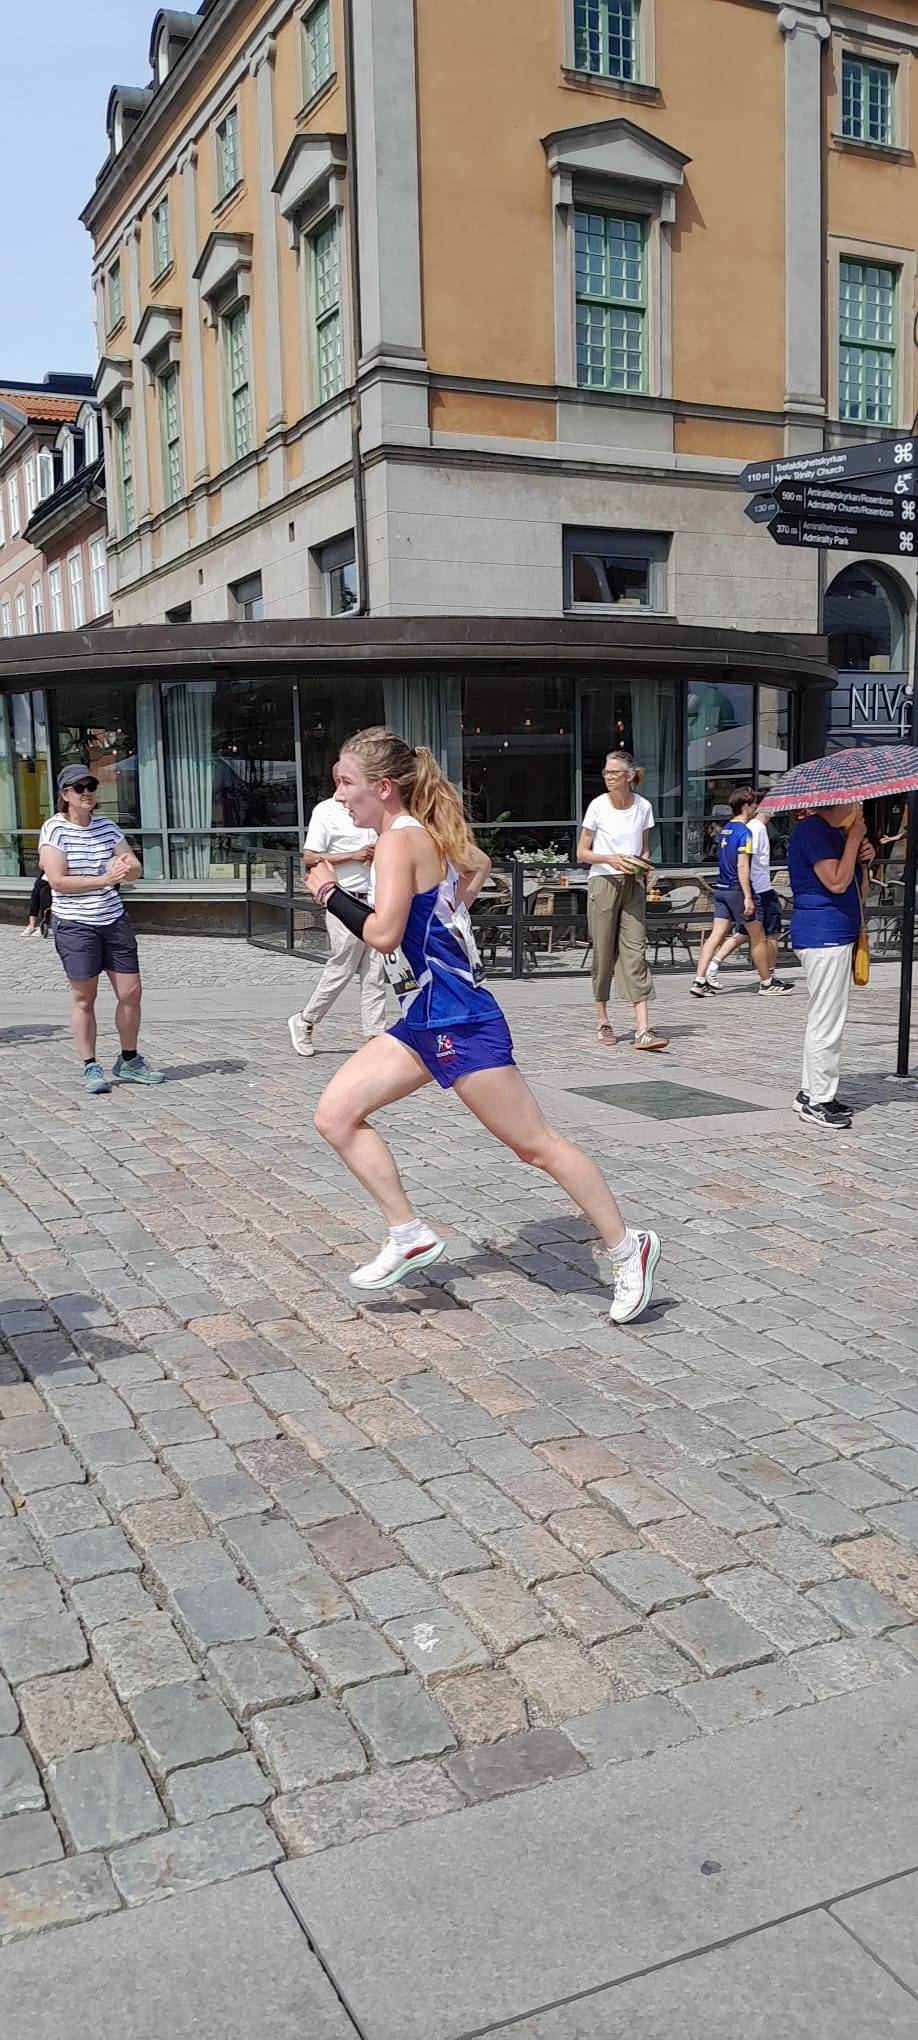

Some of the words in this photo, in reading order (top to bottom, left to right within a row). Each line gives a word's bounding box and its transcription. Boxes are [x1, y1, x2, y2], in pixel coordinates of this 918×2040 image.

[775, 454, 847, 472] Trefaldighetskyrkan
[747, 473, 761, 482] 110
[793, 470, 815, 481] Trinity
[816, 465, 845, 476] Church
[795, 494, 803, 502] m
[776, 524, 790, 534] 370
[790, 527, 798, 535] m
[802, 533, 833, 546] Admiralty
[834, 536, 849, 545] Park
